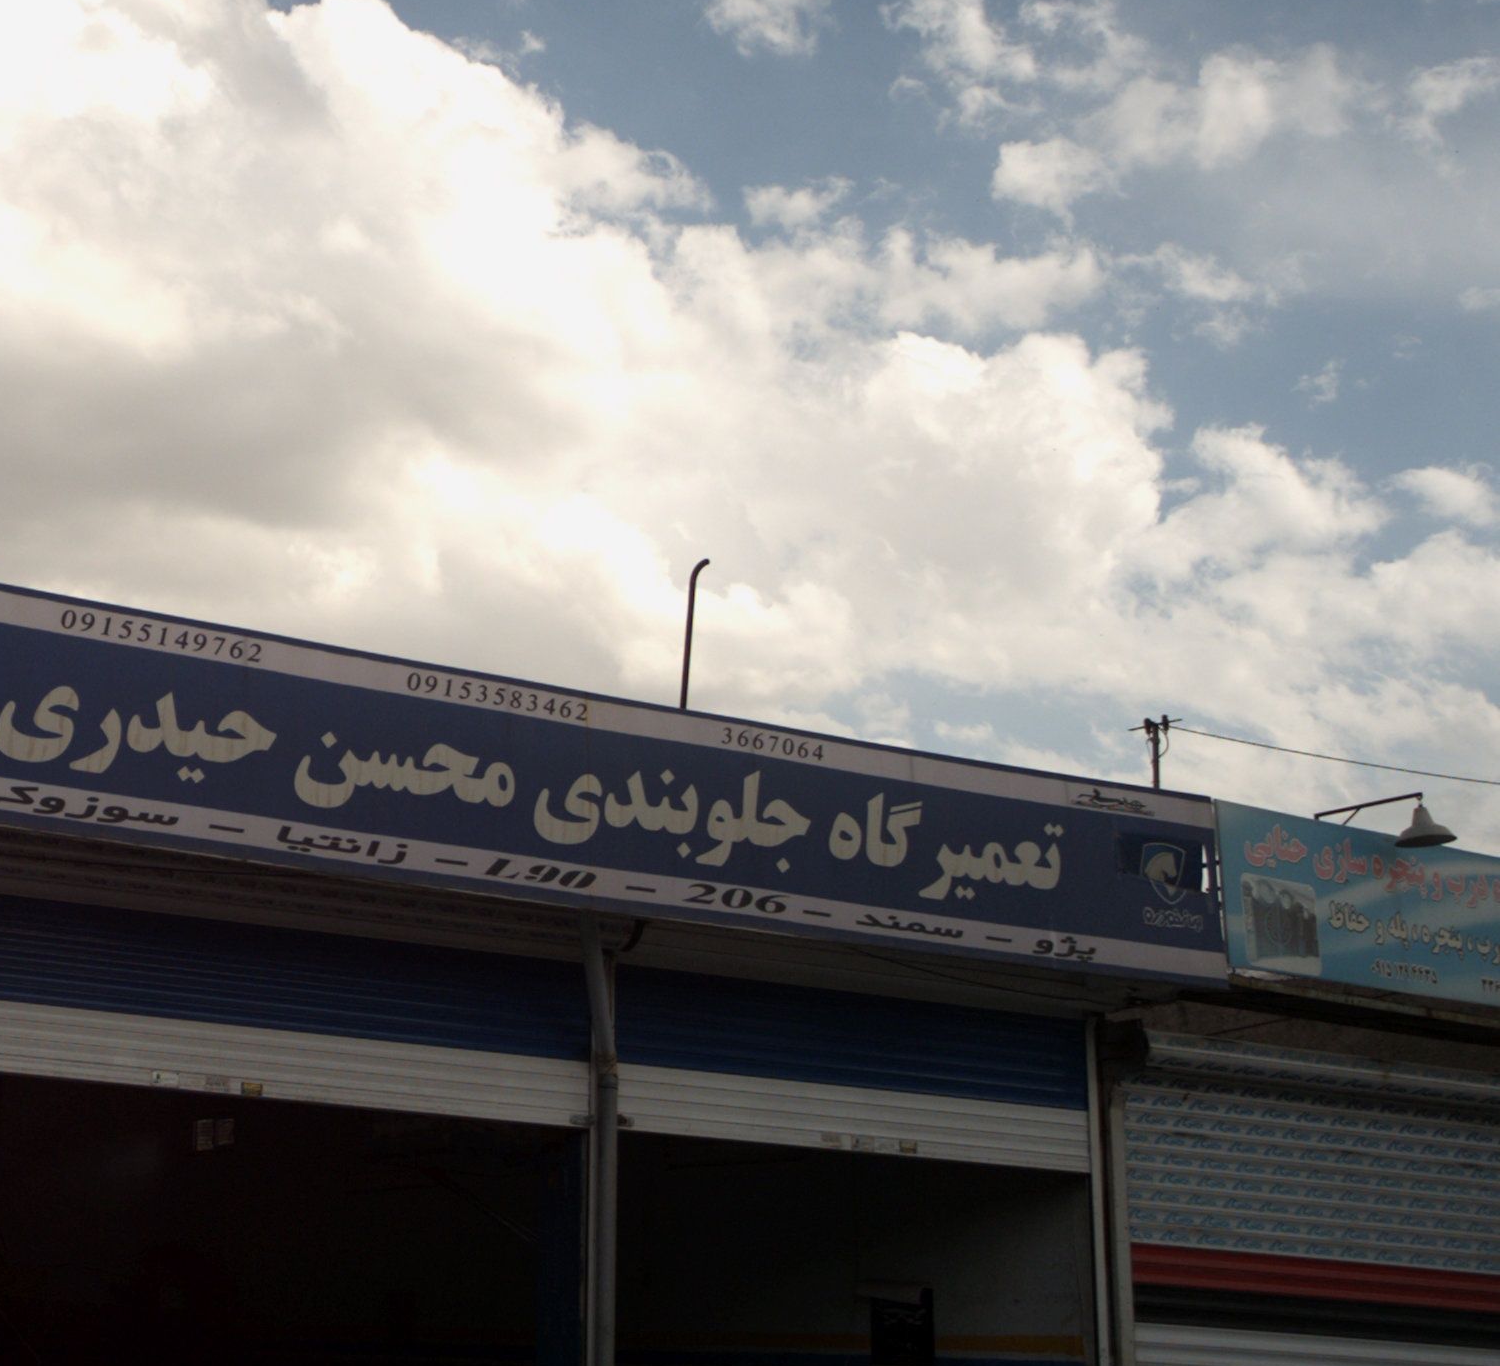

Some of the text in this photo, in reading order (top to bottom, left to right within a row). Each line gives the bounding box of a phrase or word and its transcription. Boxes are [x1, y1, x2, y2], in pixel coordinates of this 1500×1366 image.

[59, 608, 264, 663] 09155149762
[405, 672, 589, 723] 09153583462
[721, 727, 825, 762] 3667064
[293, 731, 516, 809] محسن
[533, 768, 812, 875] جلوبندی
[276, 825, 410, 865] زانتیا
[484, 856, 598, 891] L90
[684, 883, 788, 915] 206
[855, 913, 964, 939] سمند
[1032, 936, 1098, 962] پژو
